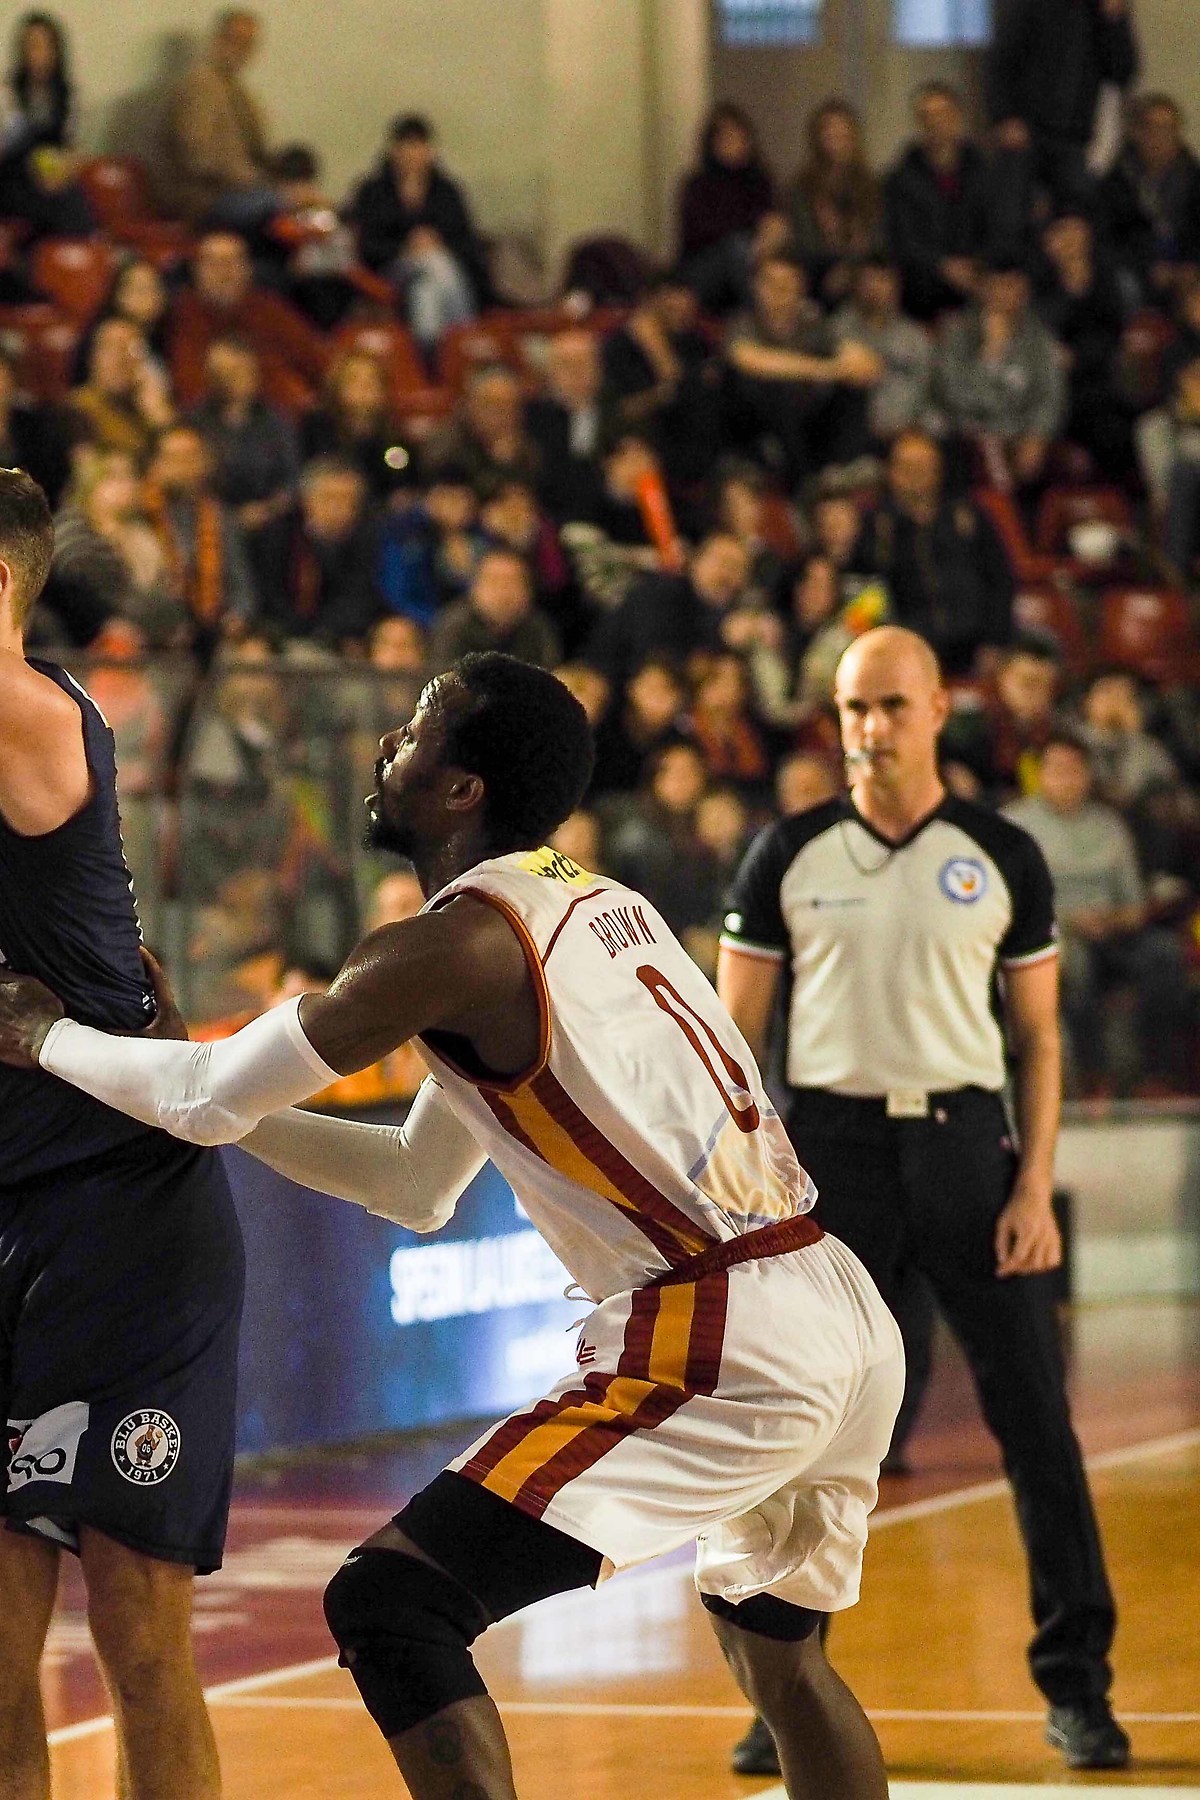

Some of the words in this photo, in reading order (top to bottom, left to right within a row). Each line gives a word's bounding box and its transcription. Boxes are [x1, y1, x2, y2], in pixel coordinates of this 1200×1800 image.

[588, 905, 657, 959] BROWN
[636, 965, 760, 1133] 0
[116, 1420, 136, 1450] BLU
[141, 1413, 178, 1459] BASKET
[126, 1466, 158, 1481] 1971
